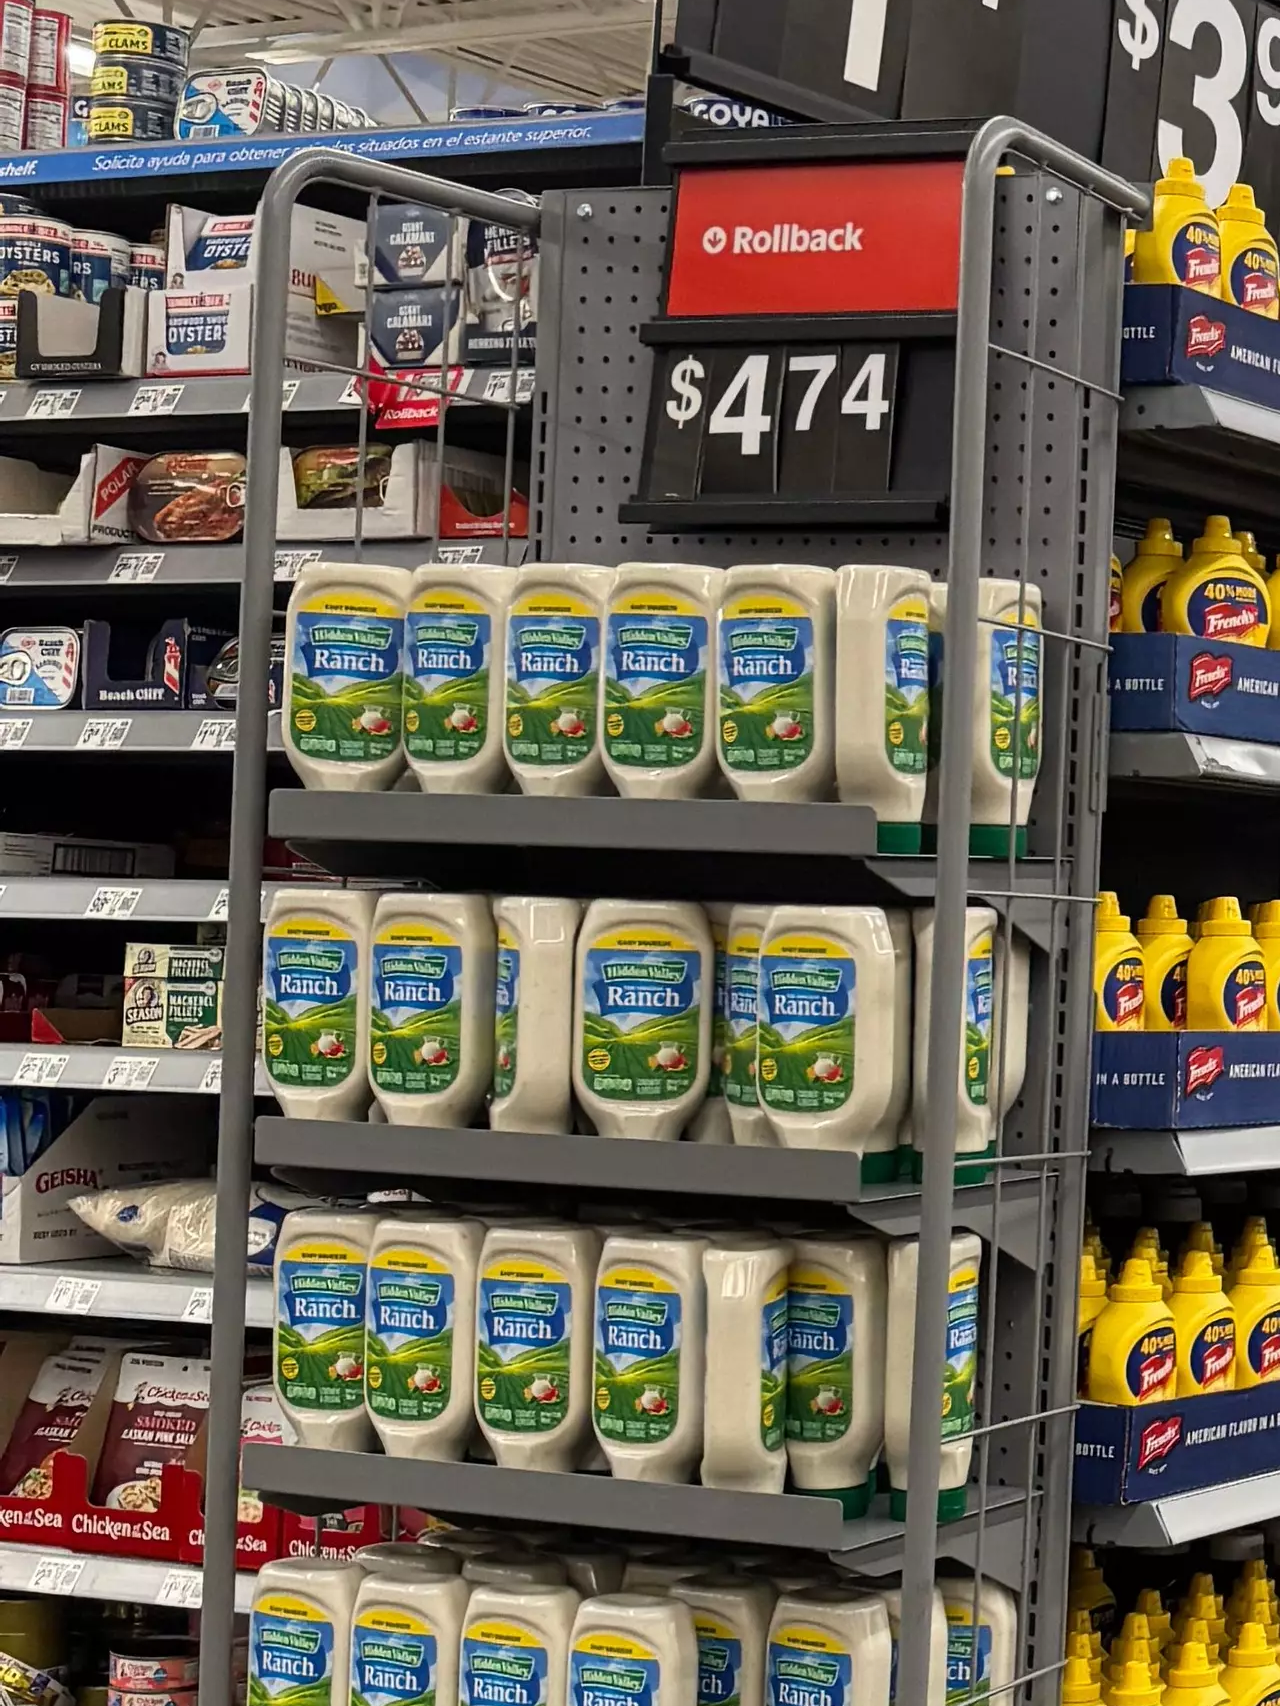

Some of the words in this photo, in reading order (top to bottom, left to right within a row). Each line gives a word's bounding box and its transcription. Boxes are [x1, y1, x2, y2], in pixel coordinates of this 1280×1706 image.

[692, 103, 769, 128] GOYA
[93, 154, 144, 171] Solicita
[148, 152, 190, 170] ayuda
[192, 152, 225, 168] para
[229, 146, 287, 161] obtener
[357, 135, 418, 152] situados
[423, 136, 443, 148] en
[448, 133, 462, 147] el
[464, 131, 522, 146] estante
[525, 127, 592, 143] superior.
[0, 160, 37, 176] shelf.
[733, 222, 864, 254] Rollback
[1230, 346, 1271, 369] AMERICAN
[92, 525, 134, 539] PRODUCT
[1207, 604, 1258, 631] French's
[315, 649, 385, 672] Ranch
[418, 649, 471, 669] Ranch
[521, 652, 579, 673] Ranch
[733, 654, 792, 677] Ranch
[100, 689, 132, 701] Beach
[136, 688, 164, 701] Cliff
[1125, 678, 1163, 691] BOTTLE
[1237, 677, 1278, 696] AMERICAN
[280, 974, 338, 995] Ranch
[384, 980, 441, 1001] Ranch
[608, 986, 679, 1007] Ranch
[774, 994, 835, 1016] Ranch
[126, 1004, 163, 1025] SEASON
[1124, 1072, 1165, 1085] BOTTLE
[1229, 1063, 1265, 1077] AMERICAN
[35, 1168, 98, 1194] GEISHA
[295, 1297, 355, 1319] Ranch
[380, 1306, 434, 1329] Ranch
[492, 1317, 551, 1339] Ranch
[608, 1325, 662, 1350] Ranch
[134, 1415, 197, 1431] SMOKED
[1186, 1425, 1227, 1446] AMERICAN
[1228, 1421, 1257, 1439] FLAVOR
[72, 1514, 131, 1539] Chicken
[142, 1521, 170, 1541] Sea
[262, 1651, 315, 1677] Ranch
[364, 1665, 418, 1691] Ranch
[473, 1678, 528, 1704] Ranch
